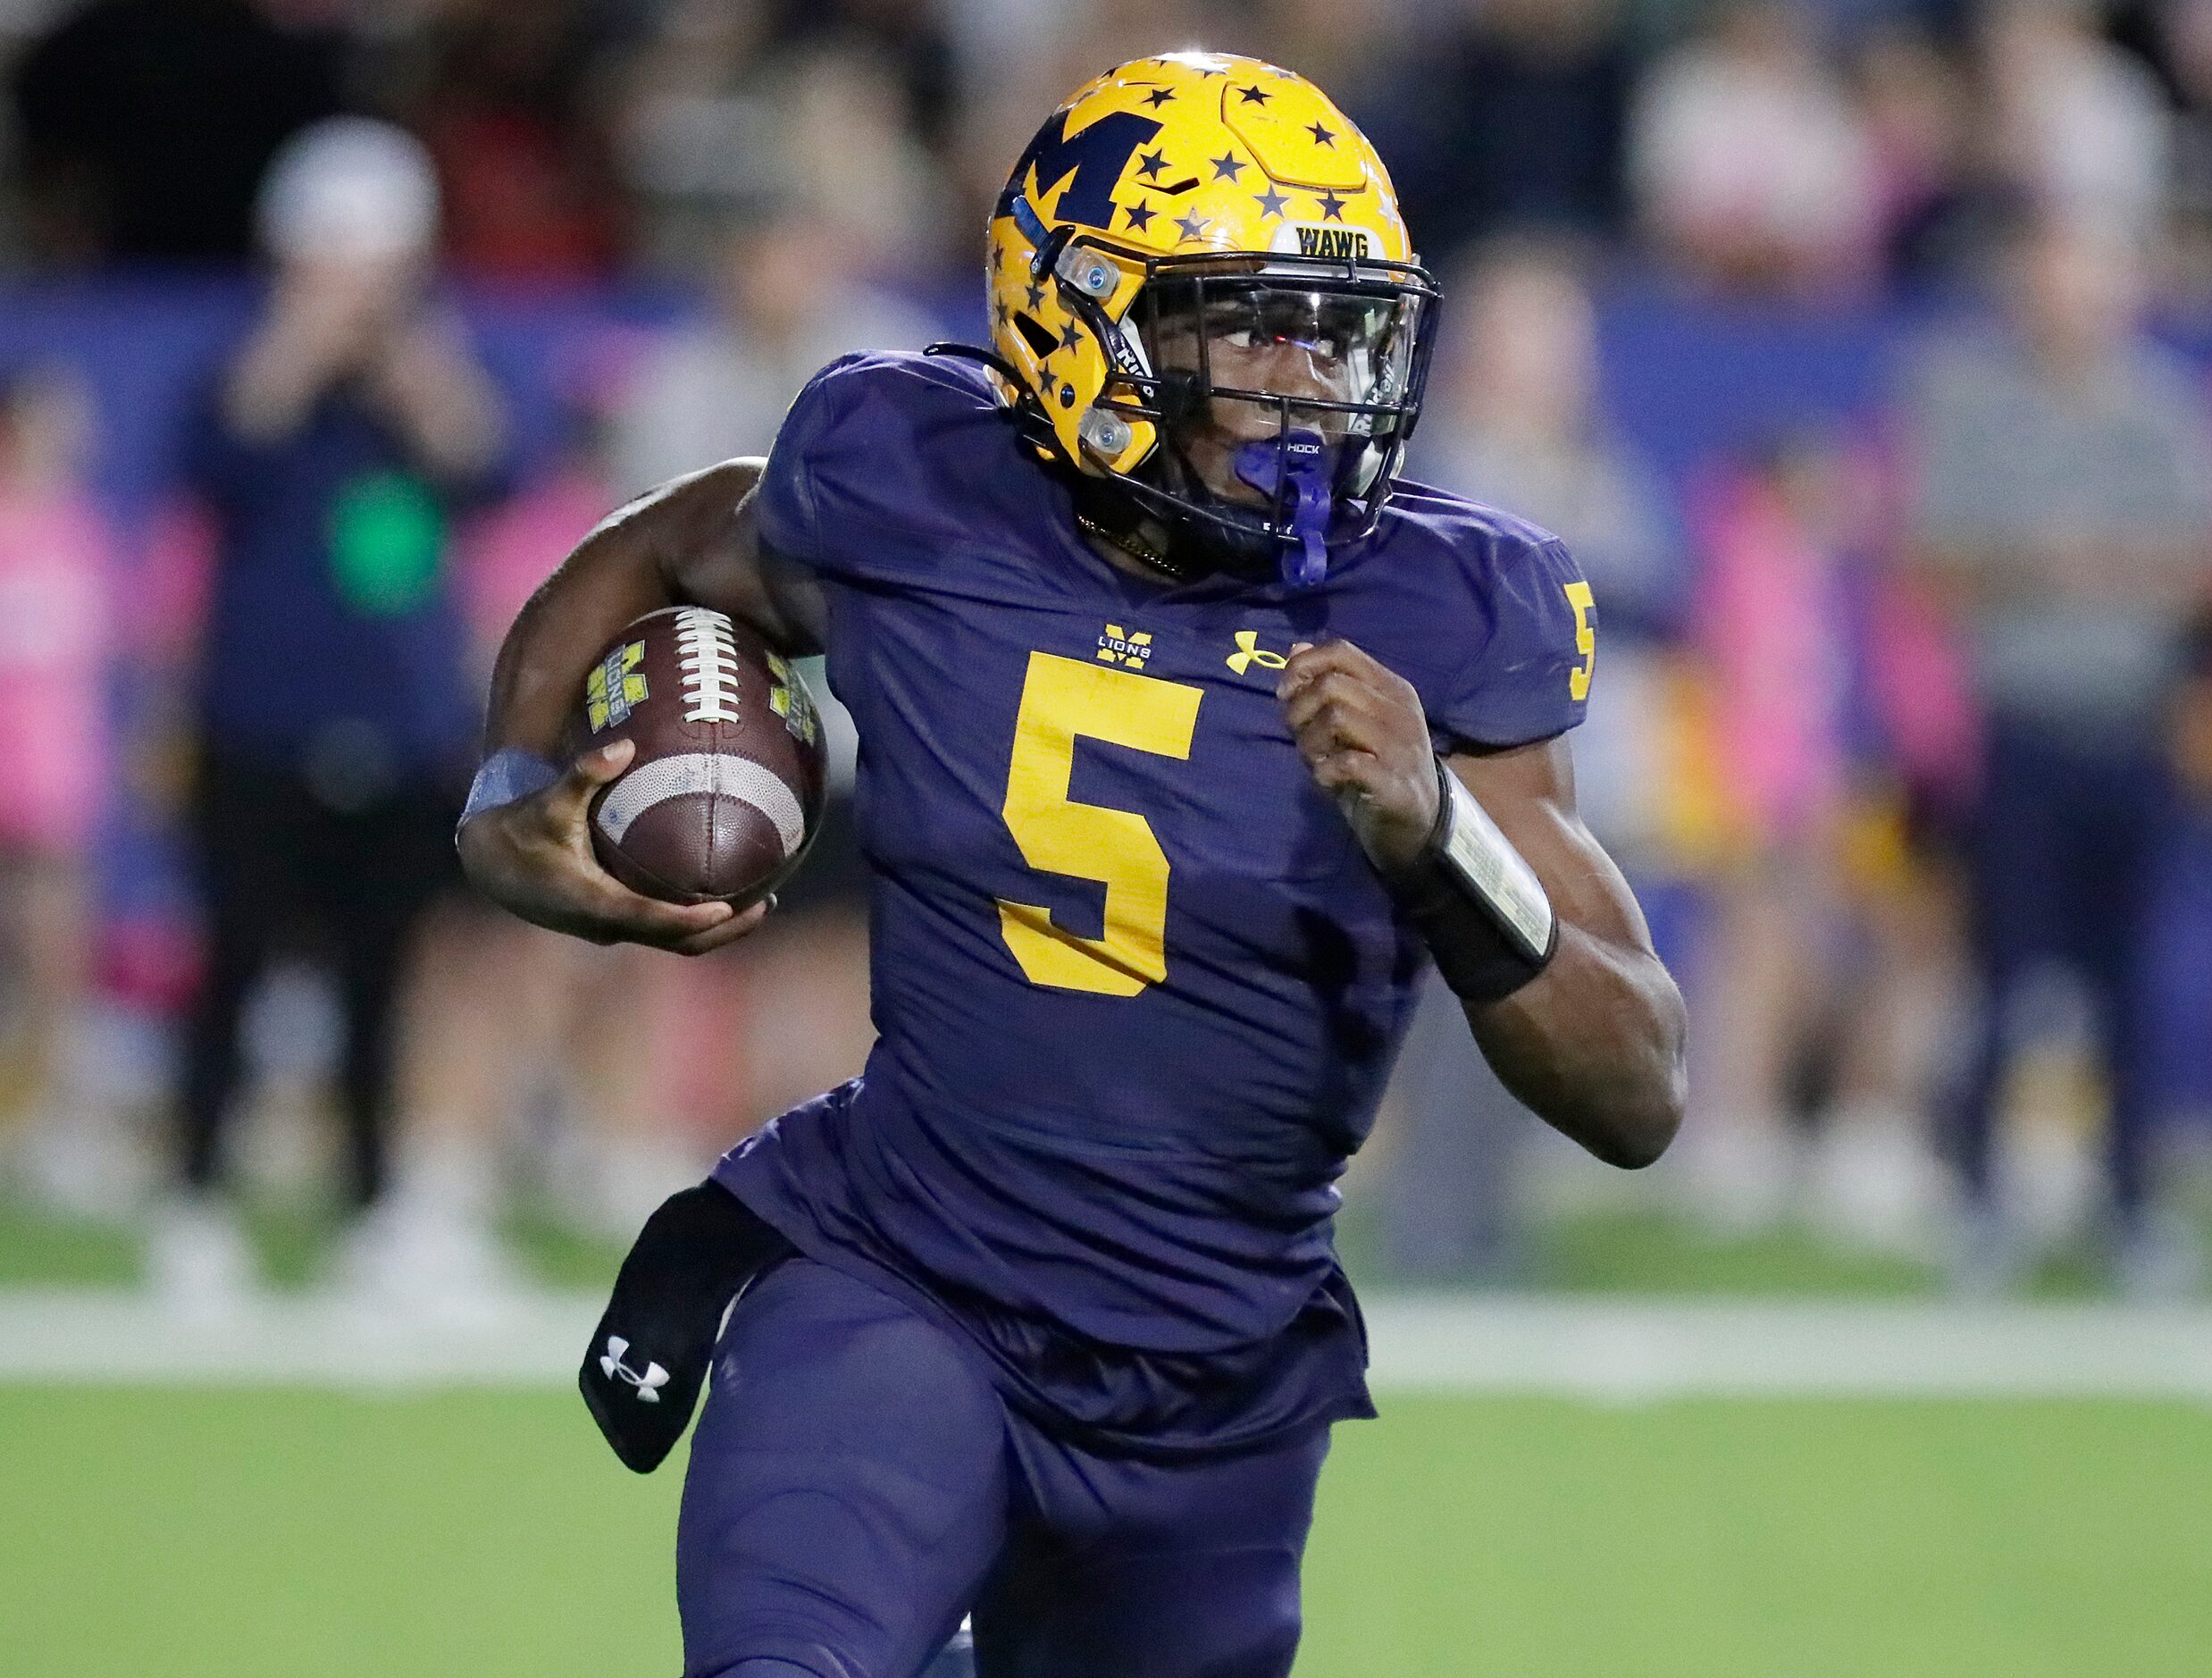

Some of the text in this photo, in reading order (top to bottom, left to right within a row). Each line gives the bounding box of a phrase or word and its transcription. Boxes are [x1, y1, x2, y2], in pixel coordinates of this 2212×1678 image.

[1295, 227, 1369, 258] WAWG
[1277, 442, 1320, 455] HOCK
[1098, 635, 1152, 659] LIONS
[1563, 581, 1596, 701] 5
[996, 650, 1205, 998] 5
